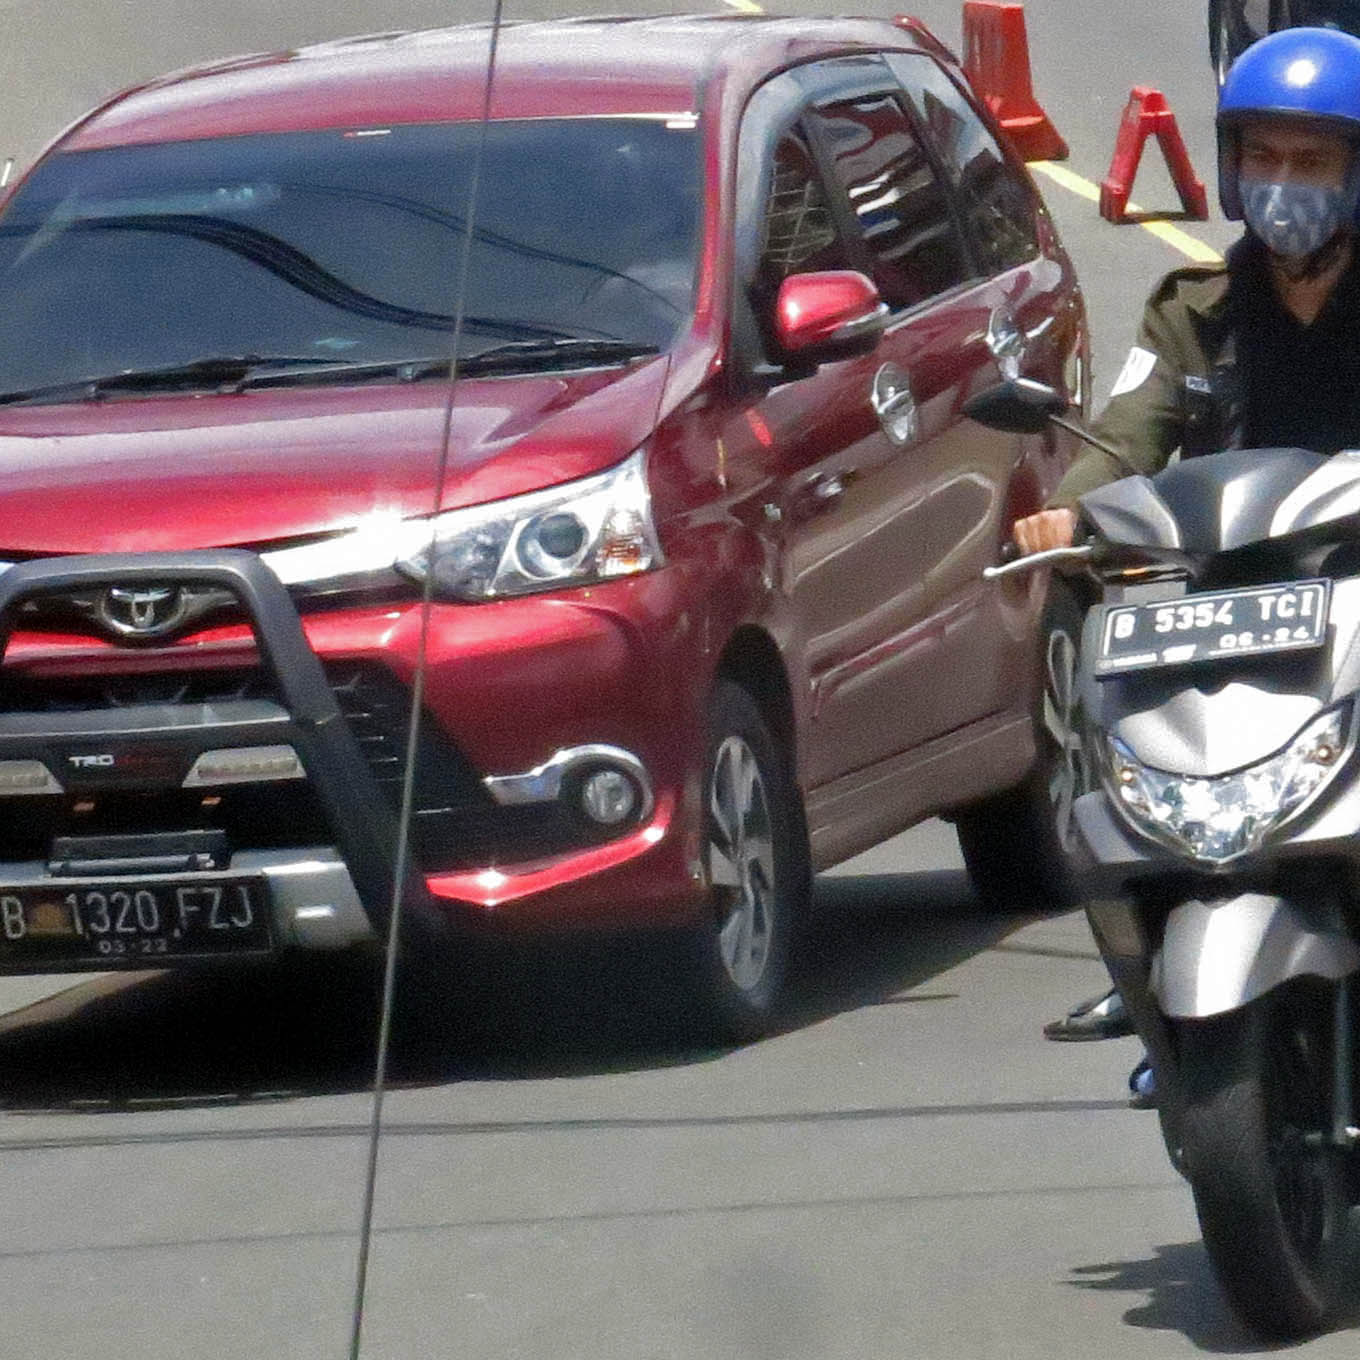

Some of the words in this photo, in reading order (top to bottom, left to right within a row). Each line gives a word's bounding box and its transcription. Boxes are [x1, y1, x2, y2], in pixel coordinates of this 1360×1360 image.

[1155, 600, 1234, 633] 5354
[1258, 590, 1315, 621] TCI
[0, 895, 26, 940] B
[63, 890, 160, 936] 1320
[176, 886, 254, 930] FZJ
